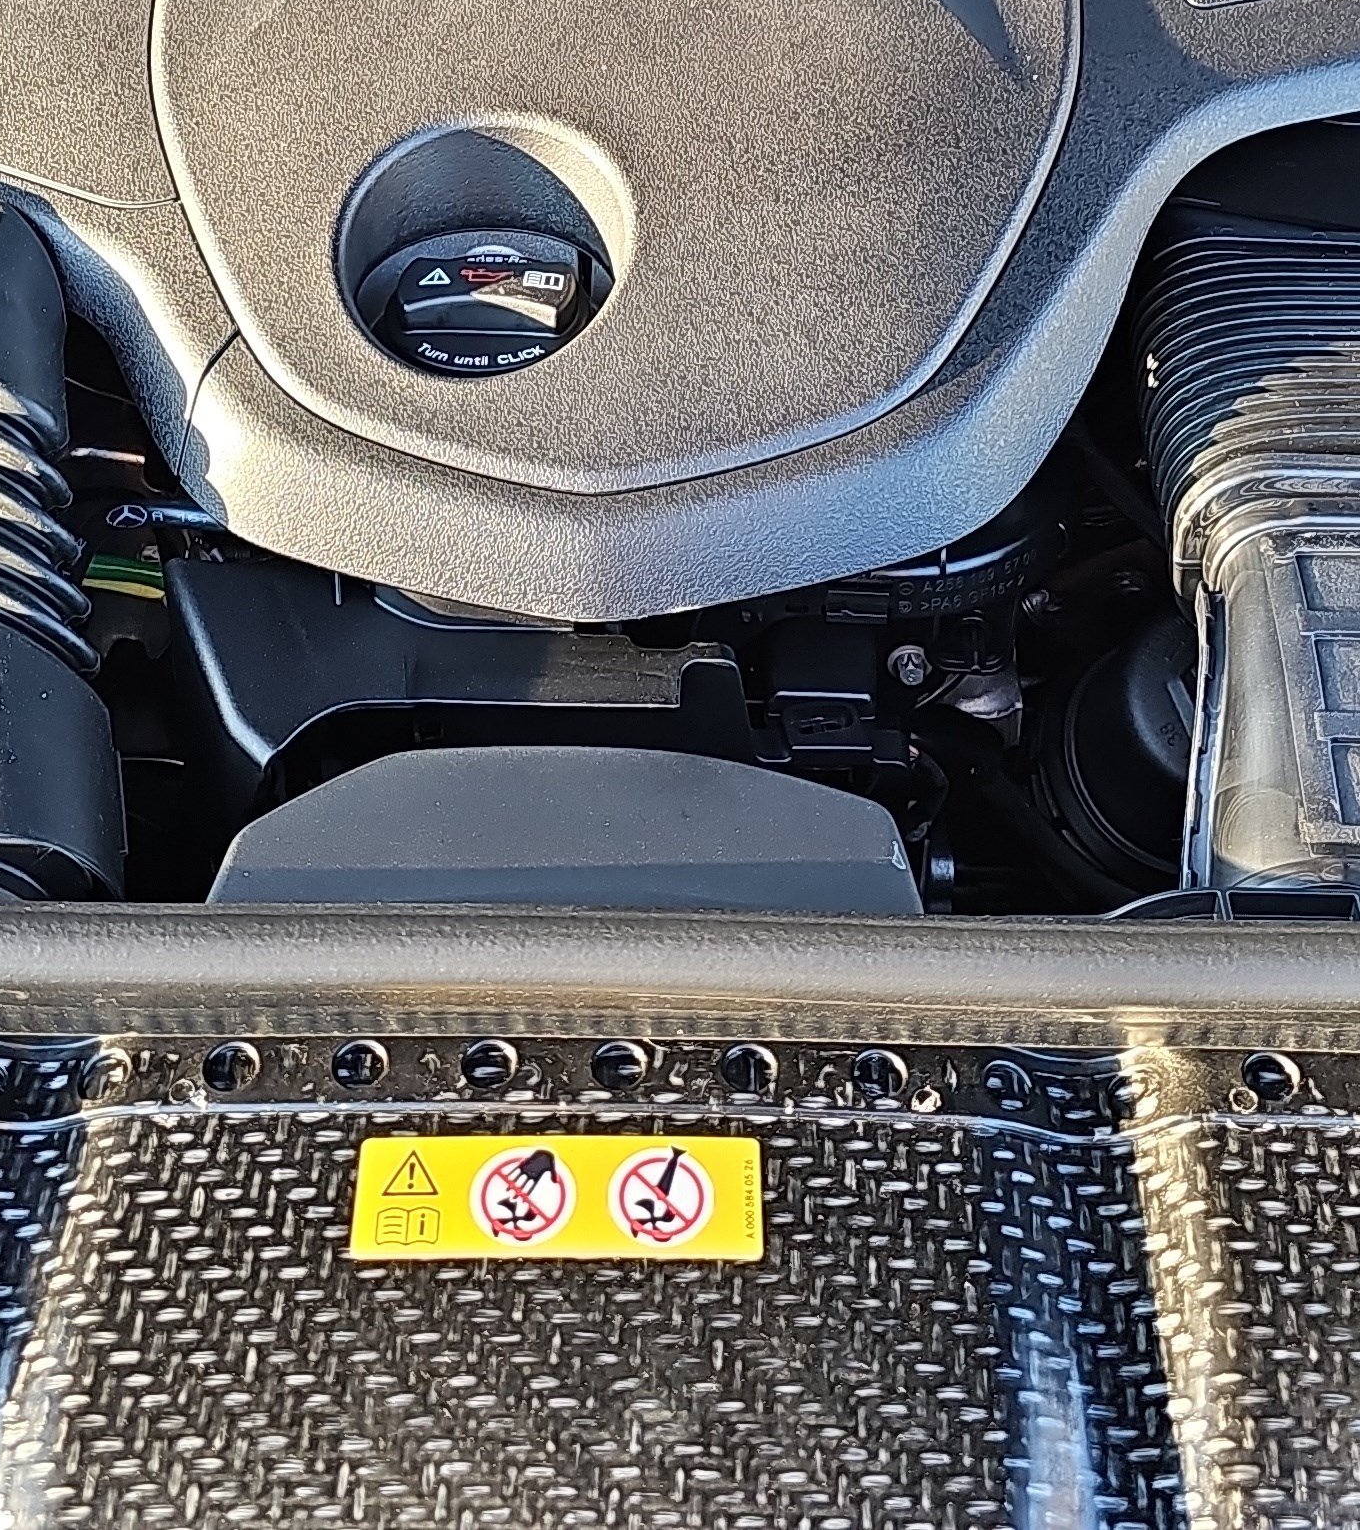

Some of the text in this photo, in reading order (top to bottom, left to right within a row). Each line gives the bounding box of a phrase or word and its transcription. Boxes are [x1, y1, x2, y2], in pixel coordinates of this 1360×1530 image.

[417, 342, 546, 366] Turn until CLICK
[743, 1159, 755, 1240] A 000 584 05 26
